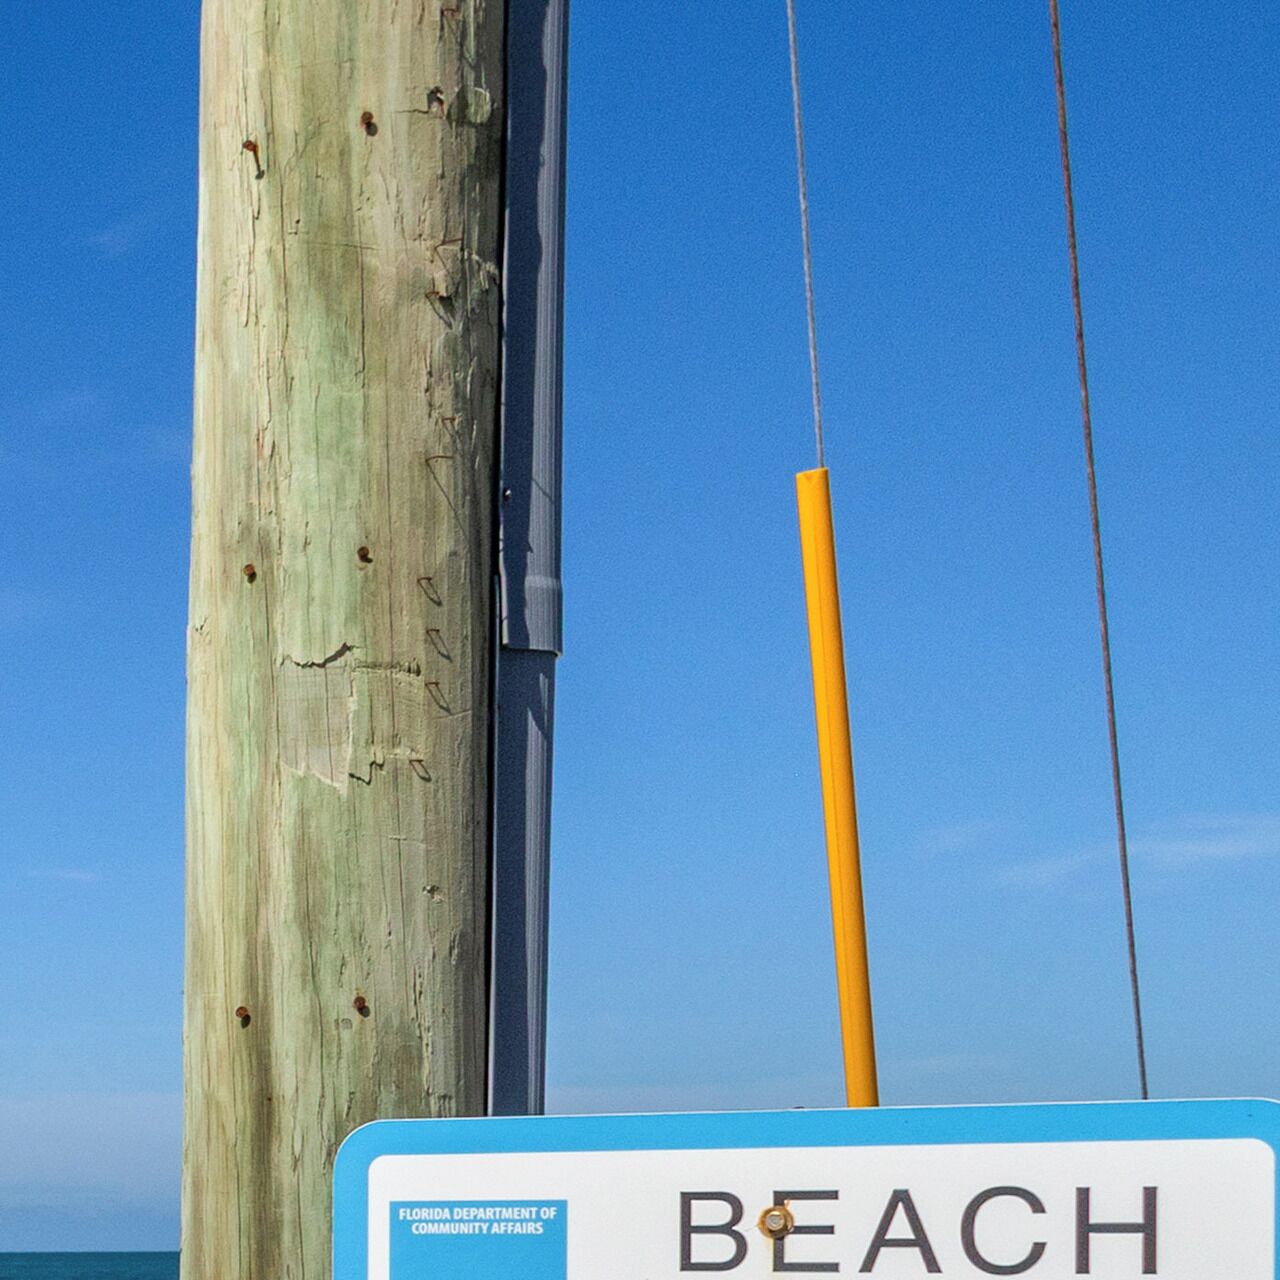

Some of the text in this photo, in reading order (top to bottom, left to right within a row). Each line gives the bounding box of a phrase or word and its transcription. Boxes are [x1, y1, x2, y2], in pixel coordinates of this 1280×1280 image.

[400, 1207, 557, 1220] FLORIDA DEPARTMENT OF
[412, 1222, 543, 1234] COMMUNITY AFFAIRS
[680, 1186, 1158, 1275] BEACH
